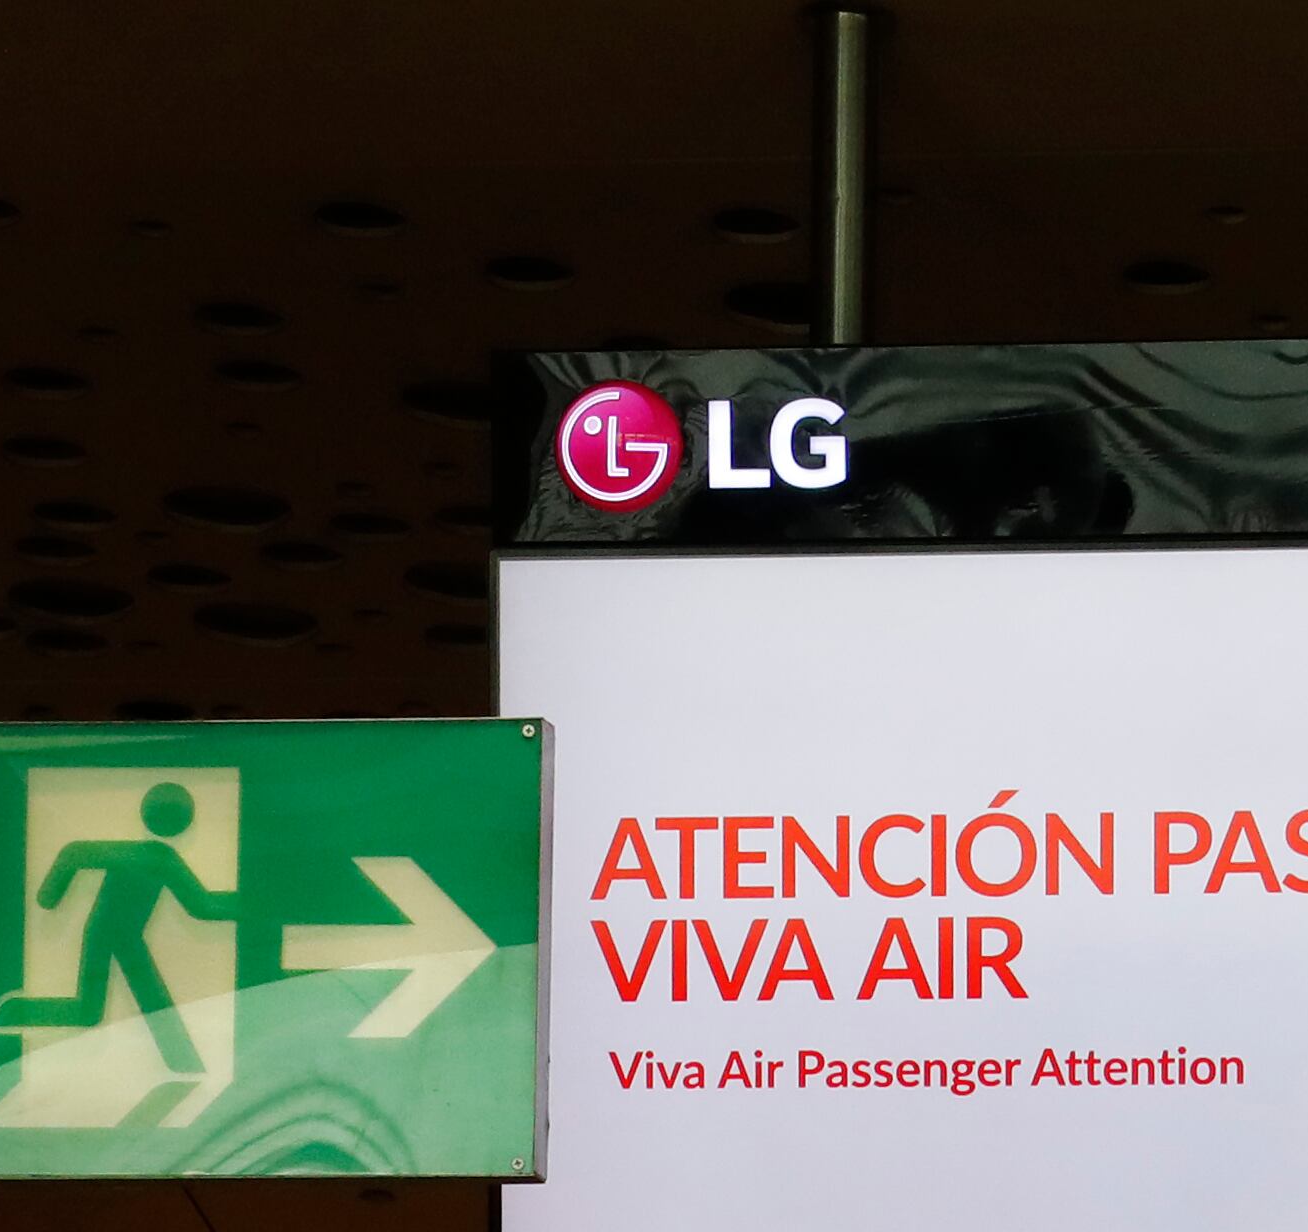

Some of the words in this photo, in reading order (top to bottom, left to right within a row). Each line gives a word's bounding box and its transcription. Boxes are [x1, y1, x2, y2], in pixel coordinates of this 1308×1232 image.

[708, 397, 848, 490] LG
[590, 789, 1114, 900] ATENCIÓN
[590, 918, 834, 1003] VIVA
[856, 916, 1029, 1000] AIR
[609, 1051, 706, 1090] Viva
[718, 1049, 783, 1089] Air
[798, 1049, 1021, 1096] Passenger
[1031, 1046, 1245, 1087] Attention
